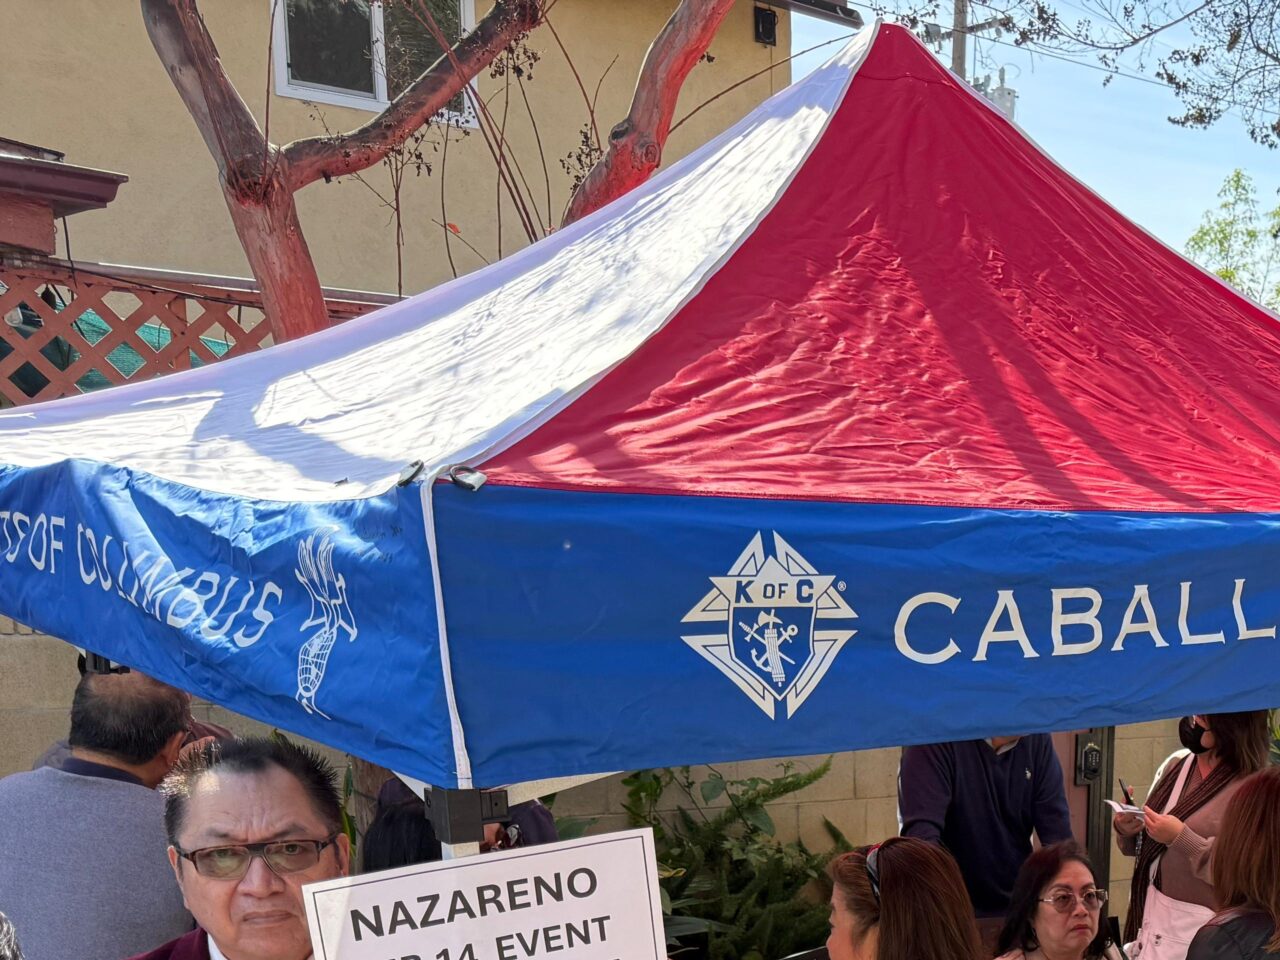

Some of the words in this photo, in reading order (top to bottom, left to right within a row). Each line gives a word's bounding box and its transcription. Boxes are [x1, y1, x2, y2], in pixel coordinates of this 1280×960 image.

[28, 513, 66, 574] OF
[734, 579, 757, 604] K
[763, 582, 789, 600] OF
[796, 578, 814, 604] C
[349, 867, 597, 942] NAZARENO
